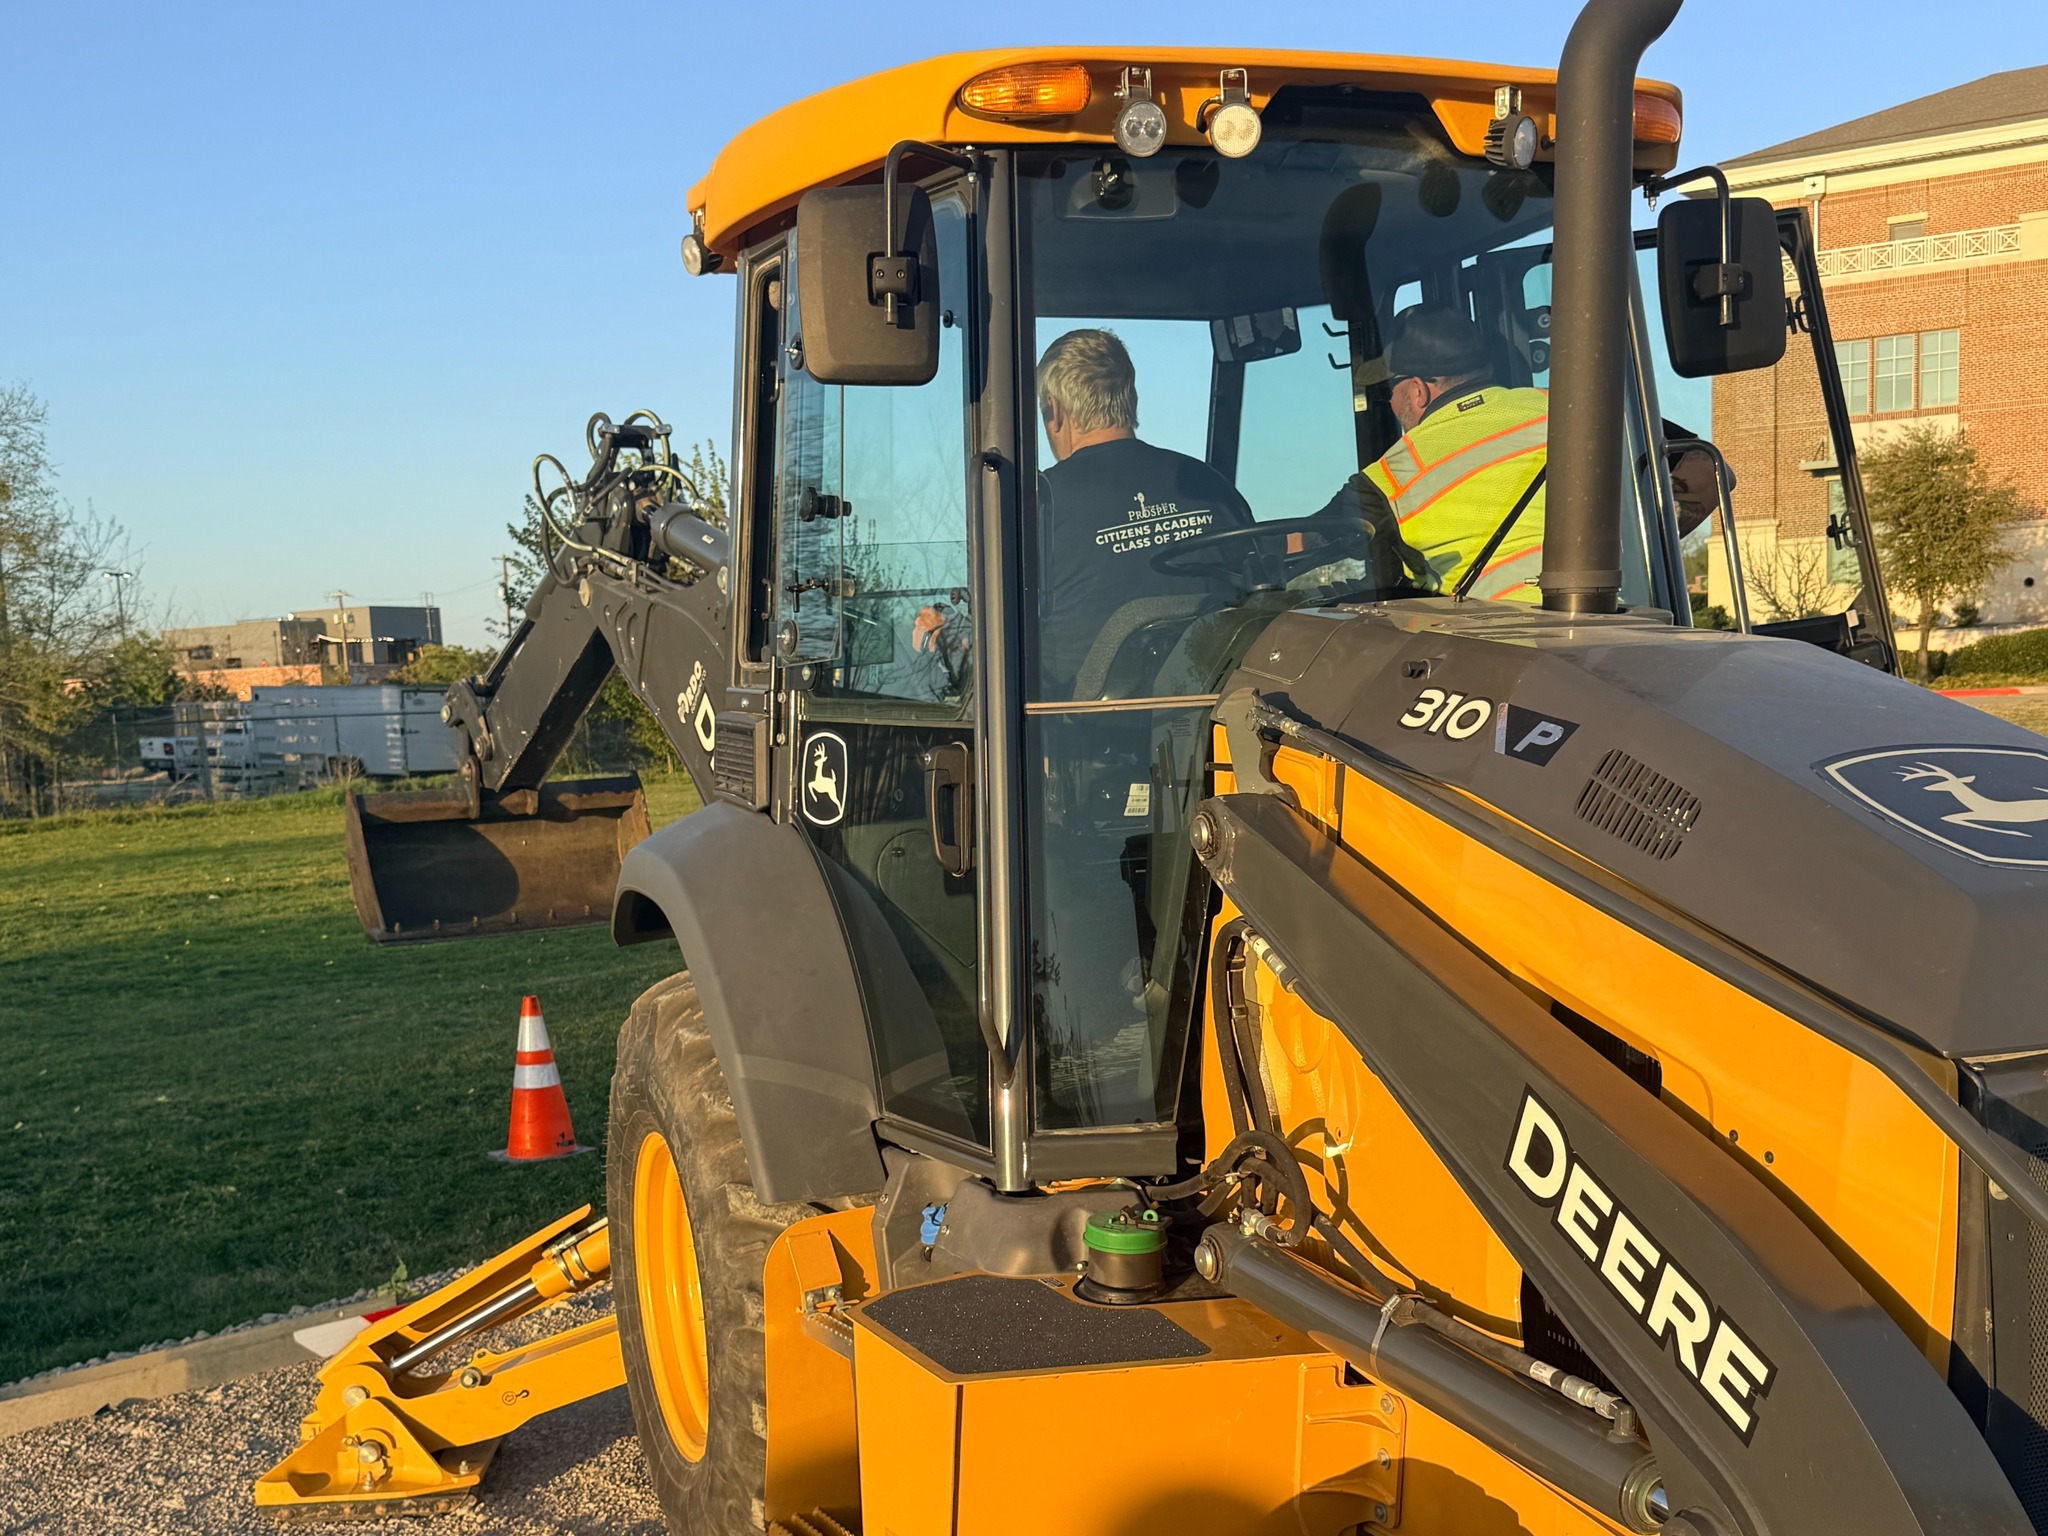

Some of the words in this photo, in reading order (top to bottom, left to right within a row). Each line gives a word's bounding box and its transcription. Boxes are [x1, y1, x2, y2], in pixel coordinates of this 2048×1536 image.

[1128, 502, 1178, 521] PROSPER
[1095, 525, 1151, 545] CITIZENS
[1154, 515, 1213, 534] ACADEMY
[1112, 537, 1151, 553] CLASS
[1154, 533, 1171, 545] OF
[1399, 688, 1492, 740] 310
[1513, 721, 1565, 753] P
[1508, 1094, 1769, 1433] DEERE
